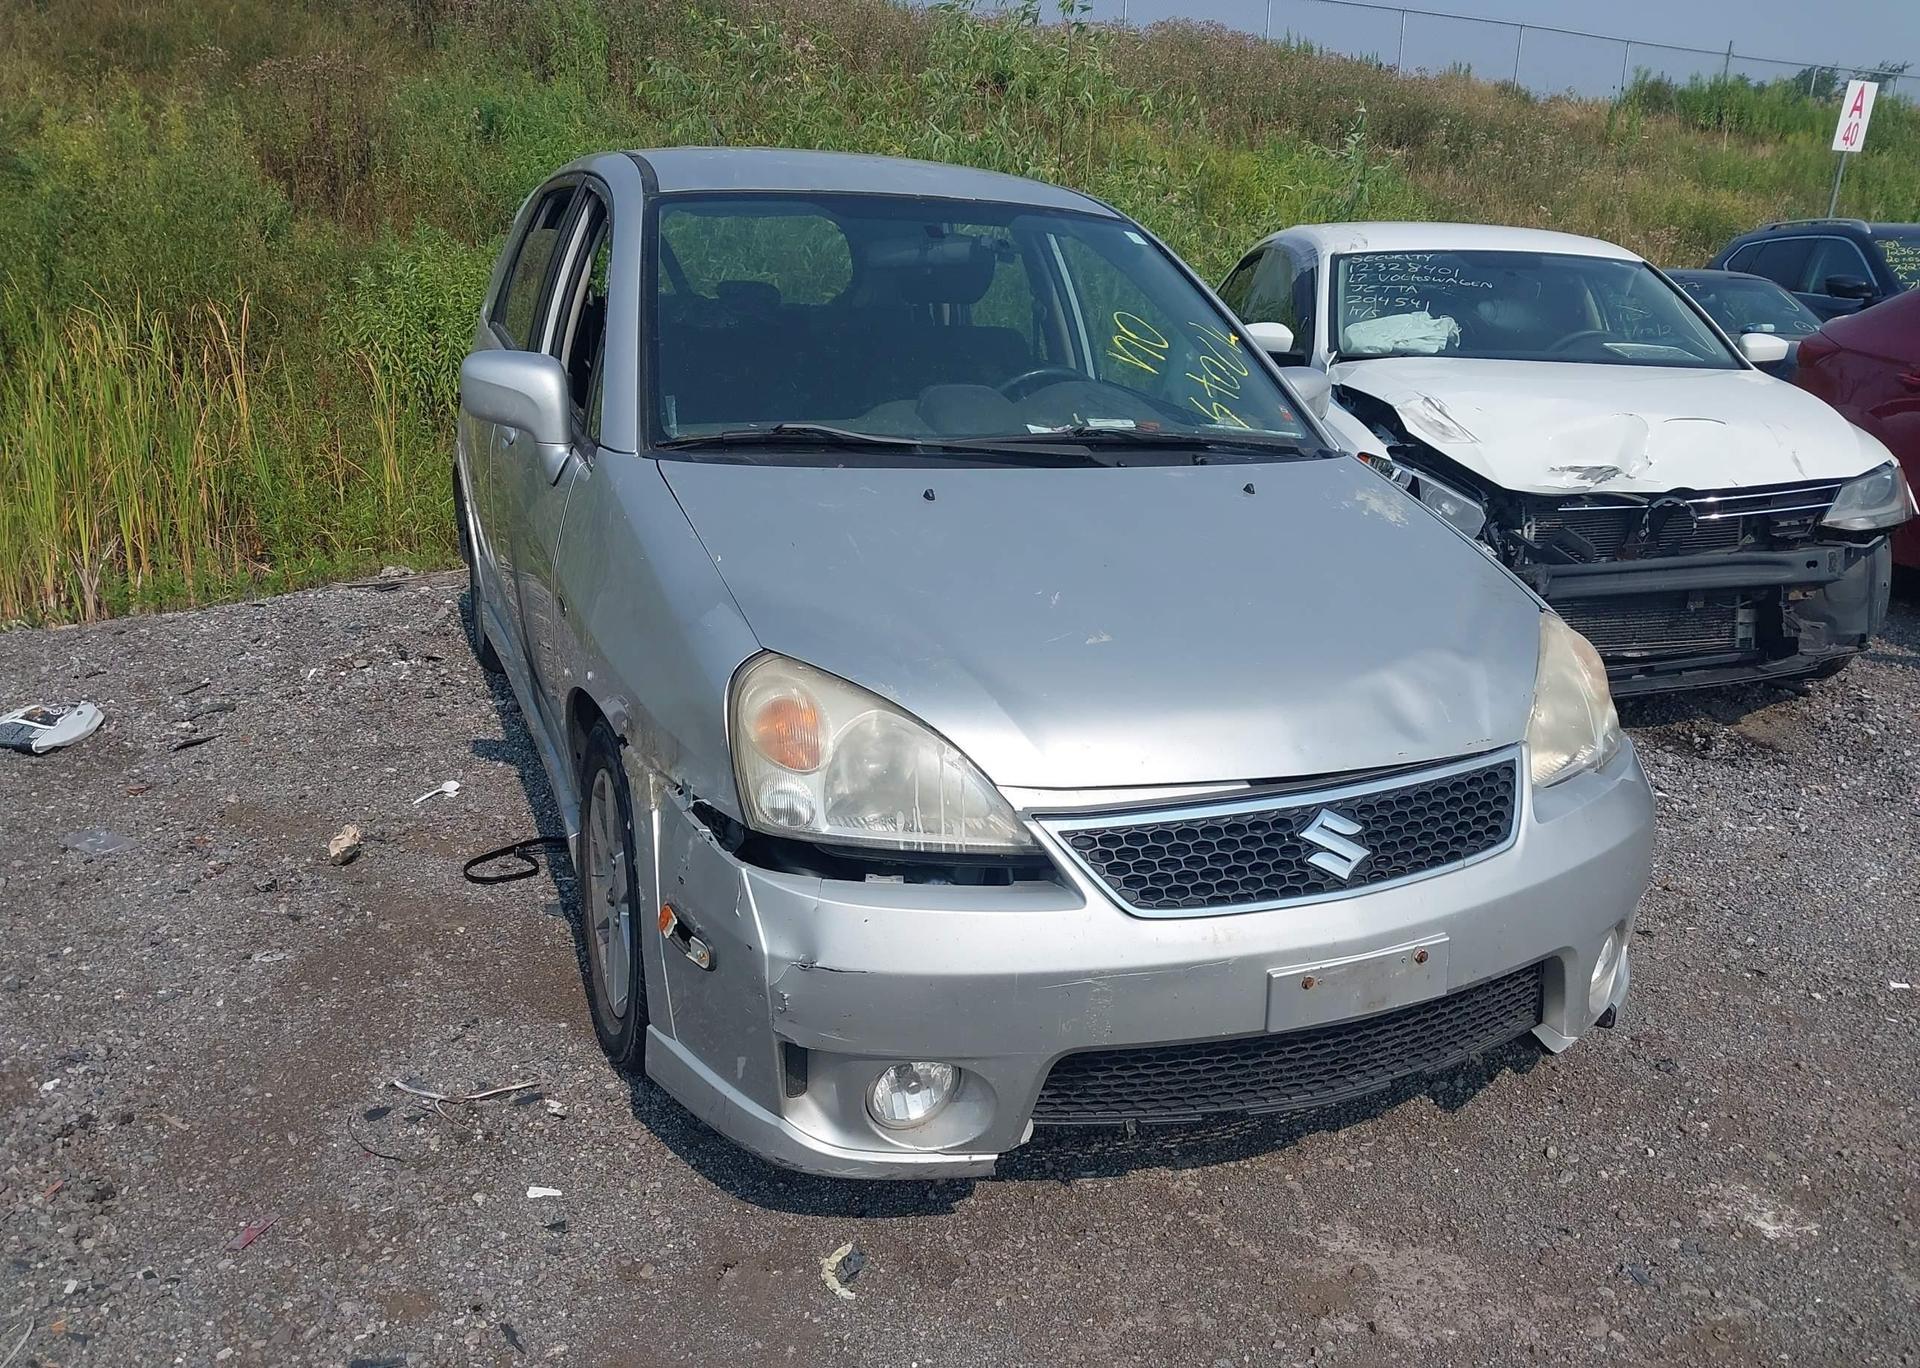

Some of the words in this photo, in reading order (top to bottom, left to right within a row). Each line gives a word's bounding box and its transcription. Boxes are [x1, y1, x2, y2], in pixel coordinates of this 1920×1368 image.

[1849, 83, 1865, 119] A
[1843, 122, 1859, 146] 40
[1352, 254, 1434, 264] SECURITY
[1350, 284, 1418, 294] JETTA
